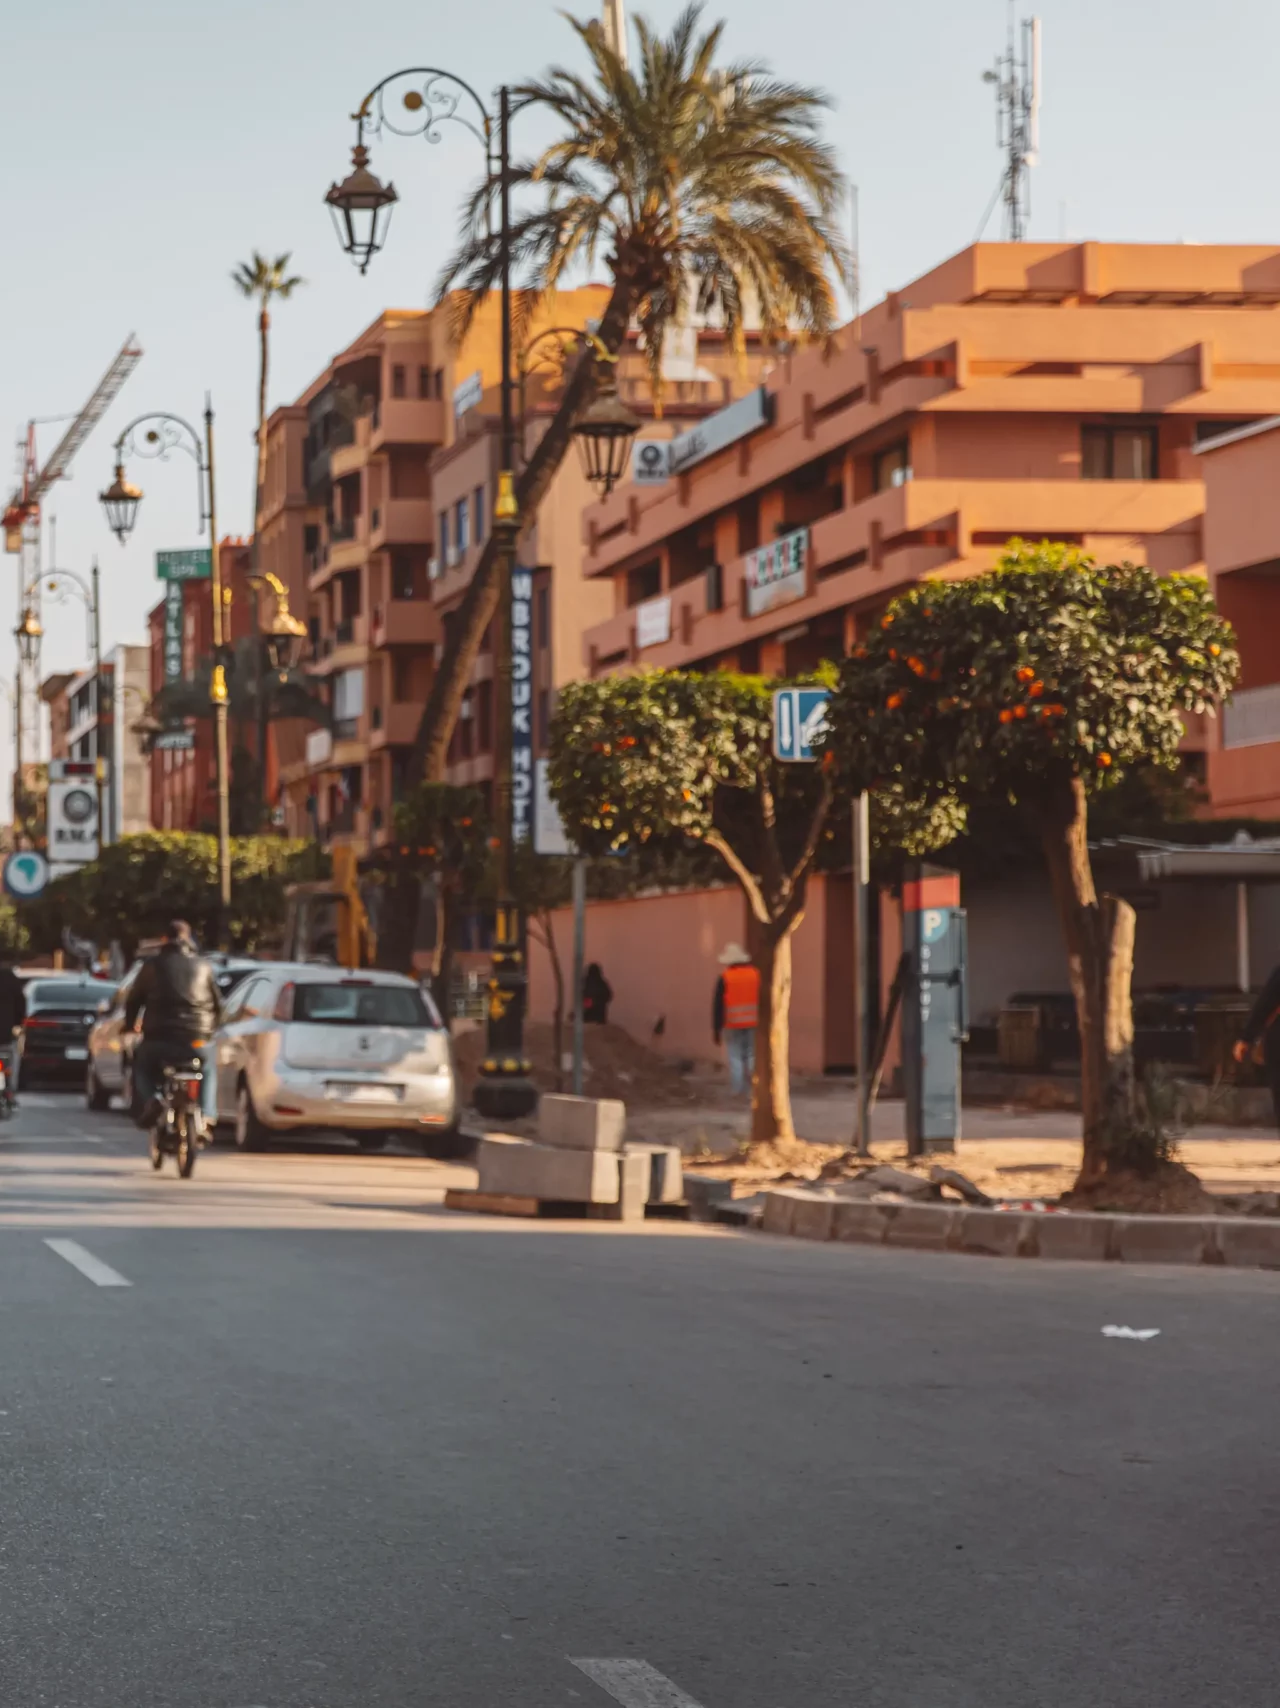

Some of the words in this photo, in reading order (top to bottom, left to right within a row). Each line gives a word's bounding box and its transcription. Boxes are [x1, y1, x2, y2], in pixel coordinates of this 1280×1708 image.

[158, 550, 210, 564] HOTEL
[166, 581, 181, 677] ATLAS
[511, 746, 532, 845] HOTE
